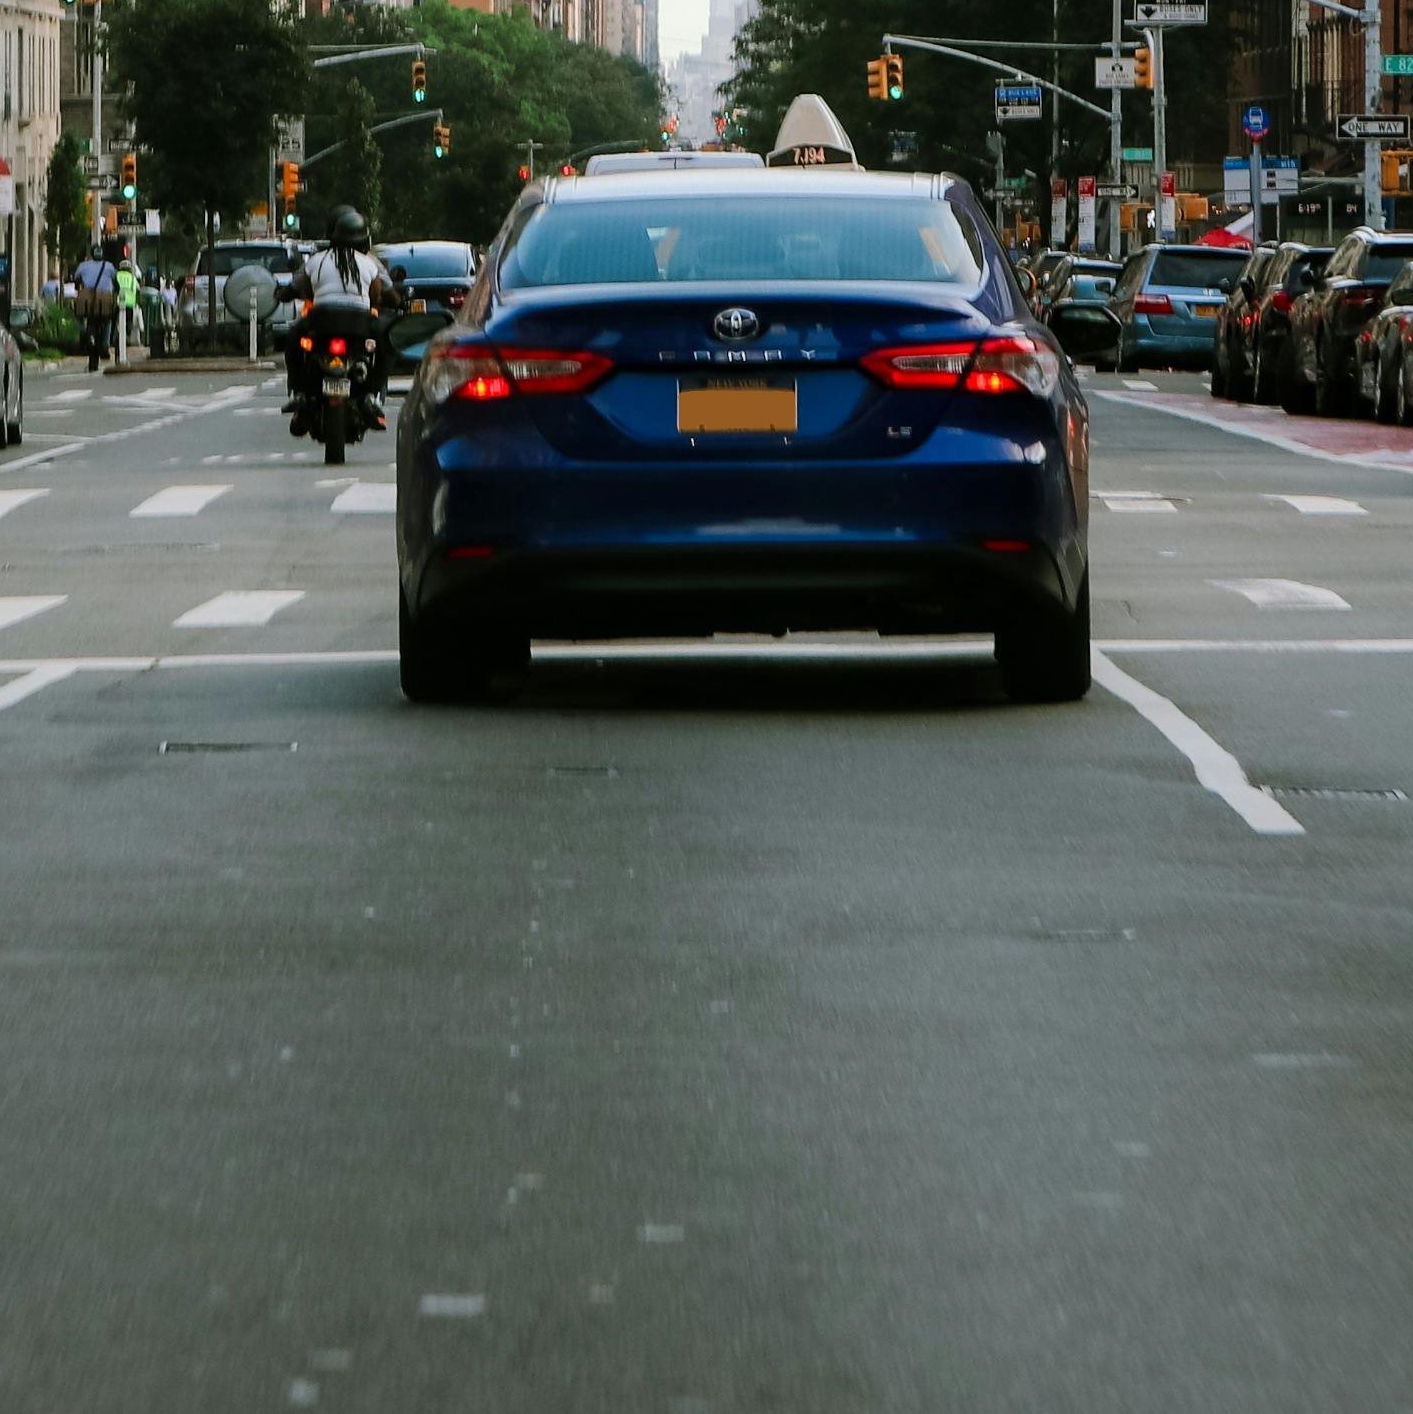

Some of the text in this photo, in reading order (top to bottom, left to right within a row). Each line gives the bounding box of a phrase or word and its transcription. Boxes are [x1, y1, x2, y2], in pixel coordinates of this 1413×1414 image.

[1385, 58, 1393, 72] E
[1348, 122, 1399, 132] ONE WAY
